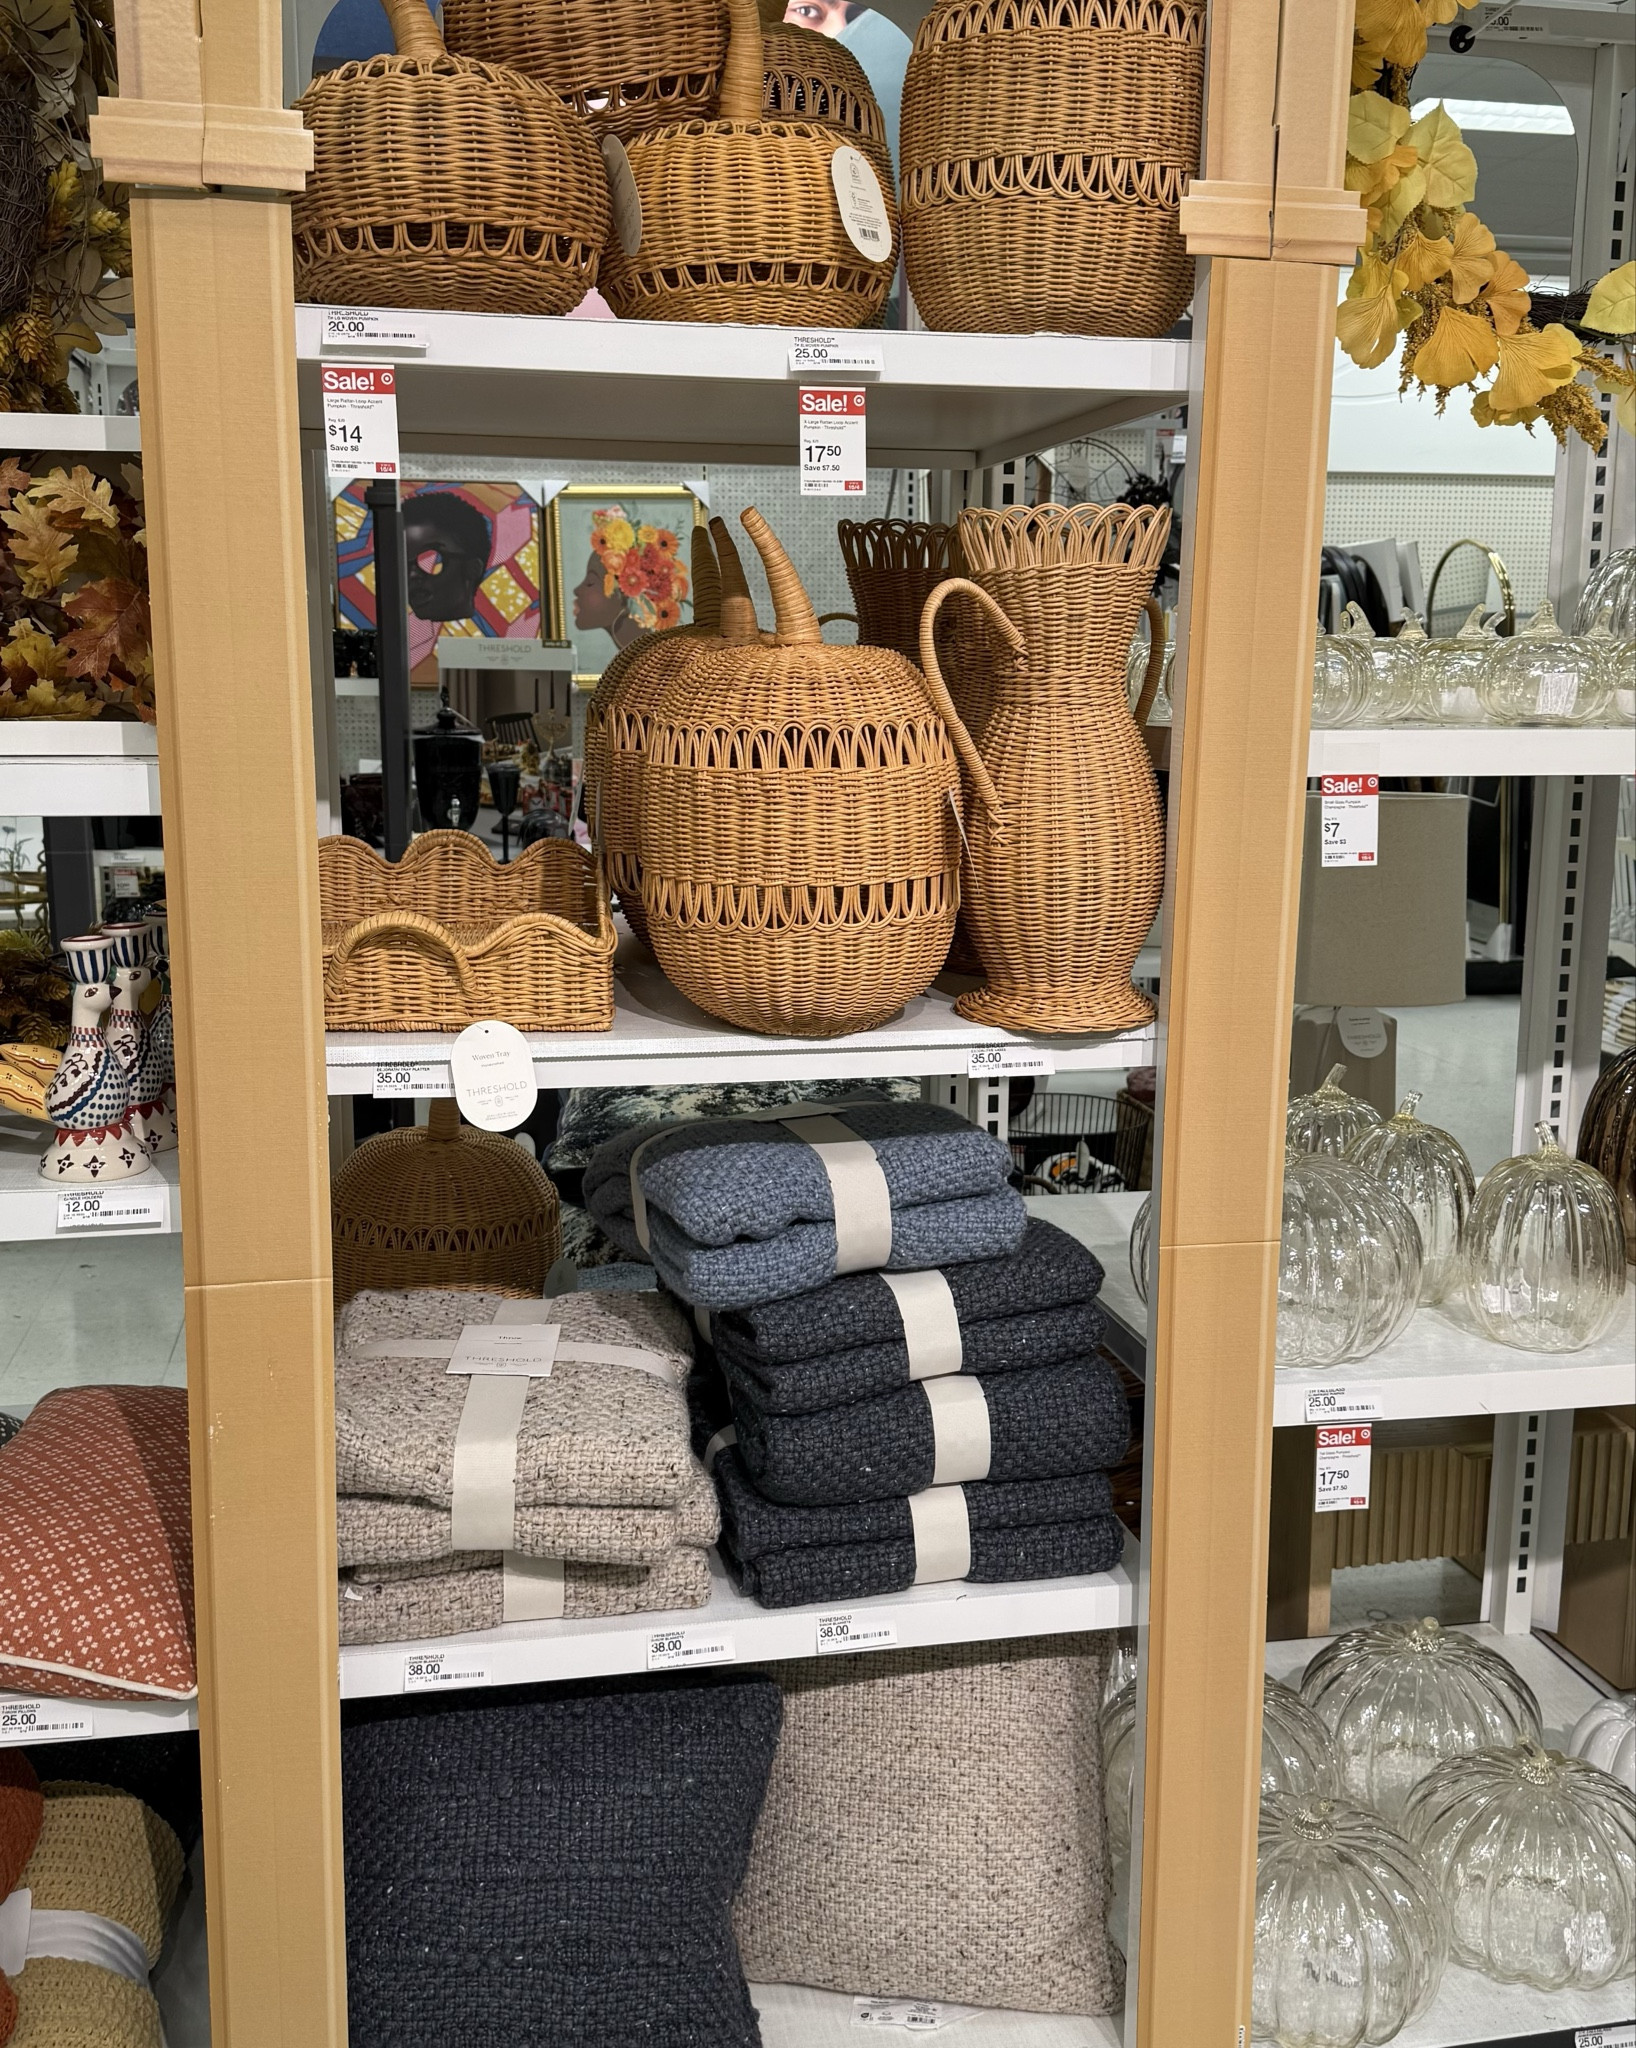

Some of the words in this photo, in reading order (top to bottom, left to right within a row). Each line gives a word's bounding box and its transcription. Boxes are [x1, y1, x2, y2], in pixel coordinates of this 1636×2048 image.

[328, 321, 365, 332] 20.00
[795, 348, 828, 358] 25.00
[323, 370, 375, 391] Sale!
[802, 393, 848, 412] Sale!
[328, 424, 363, 443] $14
[478, 644, 532, 654] THRESHOLD
[1323, 777, 1363, 794] Sale!
[1324, 822, 1340, 837] $7
[472, 1053, 494, 1061] Woven
[495, 1050, 510, 1058] Tray
[972, 1052, 1002, 1063] 35.00
[377, 1072, 410, 1083] 35.00
[466, 1080, 527, 1097] THRESHOLD
[65, 1200, 100, 1212] 12.00
[466, 1355, 542, 1363] THRESHOLD
[1308, 1396, 1336, 1407] 25.00
[1318, 1429, 1356, 1446] Sale!
[818, 1615, 852, 1623] THRESHOLD
[820, 1625, 849, 1638] 38.00
[651, 1640, 681, 1653] 38.00
[408, 1663, 440, 1676] 38.00
[2, 1714, 36, 1726] 25.00
[1578, 2035, 1603, 2047] 25.00
